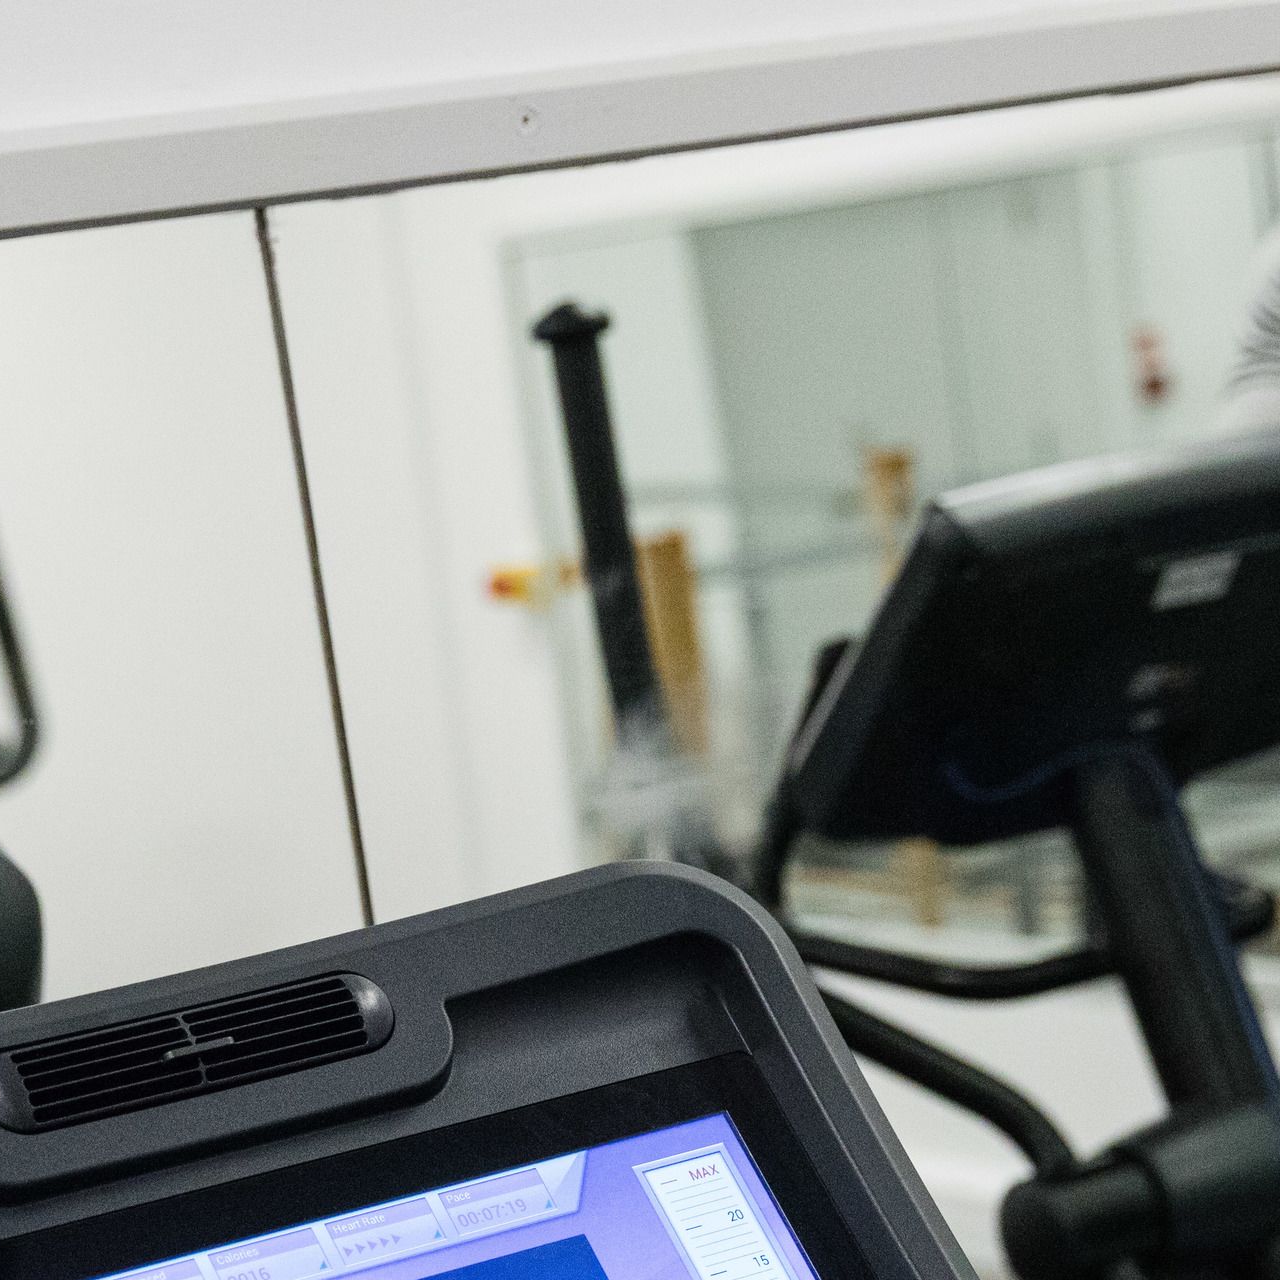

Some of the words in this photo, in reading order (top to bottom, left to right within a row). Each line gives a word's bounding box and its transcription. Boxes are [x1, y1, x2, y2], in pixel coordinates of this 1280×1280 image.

[688, 1164, 719, 1181] MAX
[446, 1190, 471, 1204] Pace
[458, 1199, 527, 1228] 00:07:19
[727, 1209, 744, 1222] 20
[332, 1219, 361, 1235] Heart
[362, 1212, 386, 1228] Rate
[216, 1246, 260, 1266] Calories
[752, 1254, 770, 1267] 15
